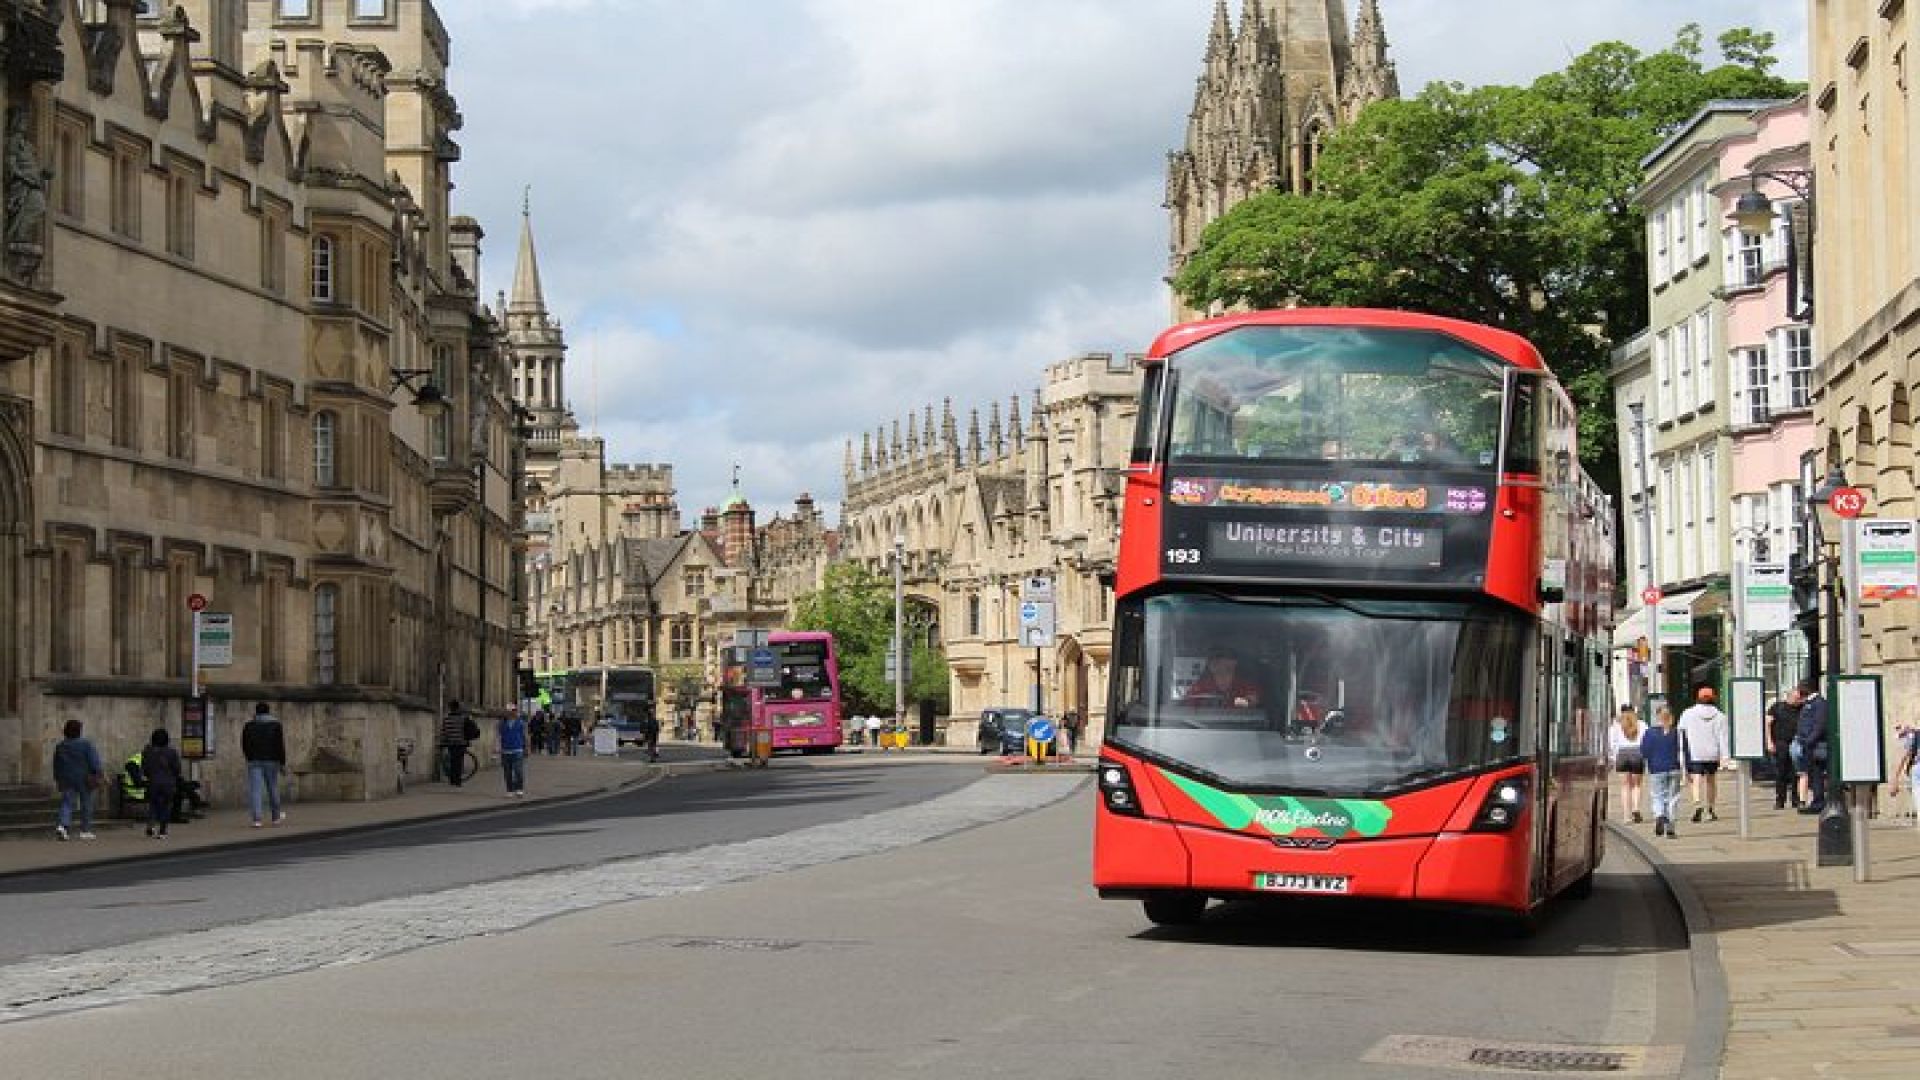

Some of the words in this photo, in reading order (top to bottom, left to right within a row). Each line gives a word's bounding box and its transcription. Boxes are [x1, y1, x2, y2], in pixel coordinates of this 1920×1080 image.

[1834, 494, 1860, 510] K3
[1226, 521, 1343, 546] University
[1352, 525, 1367, 546] &
[1378, 527, 1425, 548] City
[1167, 548, 1201, 564] 193
